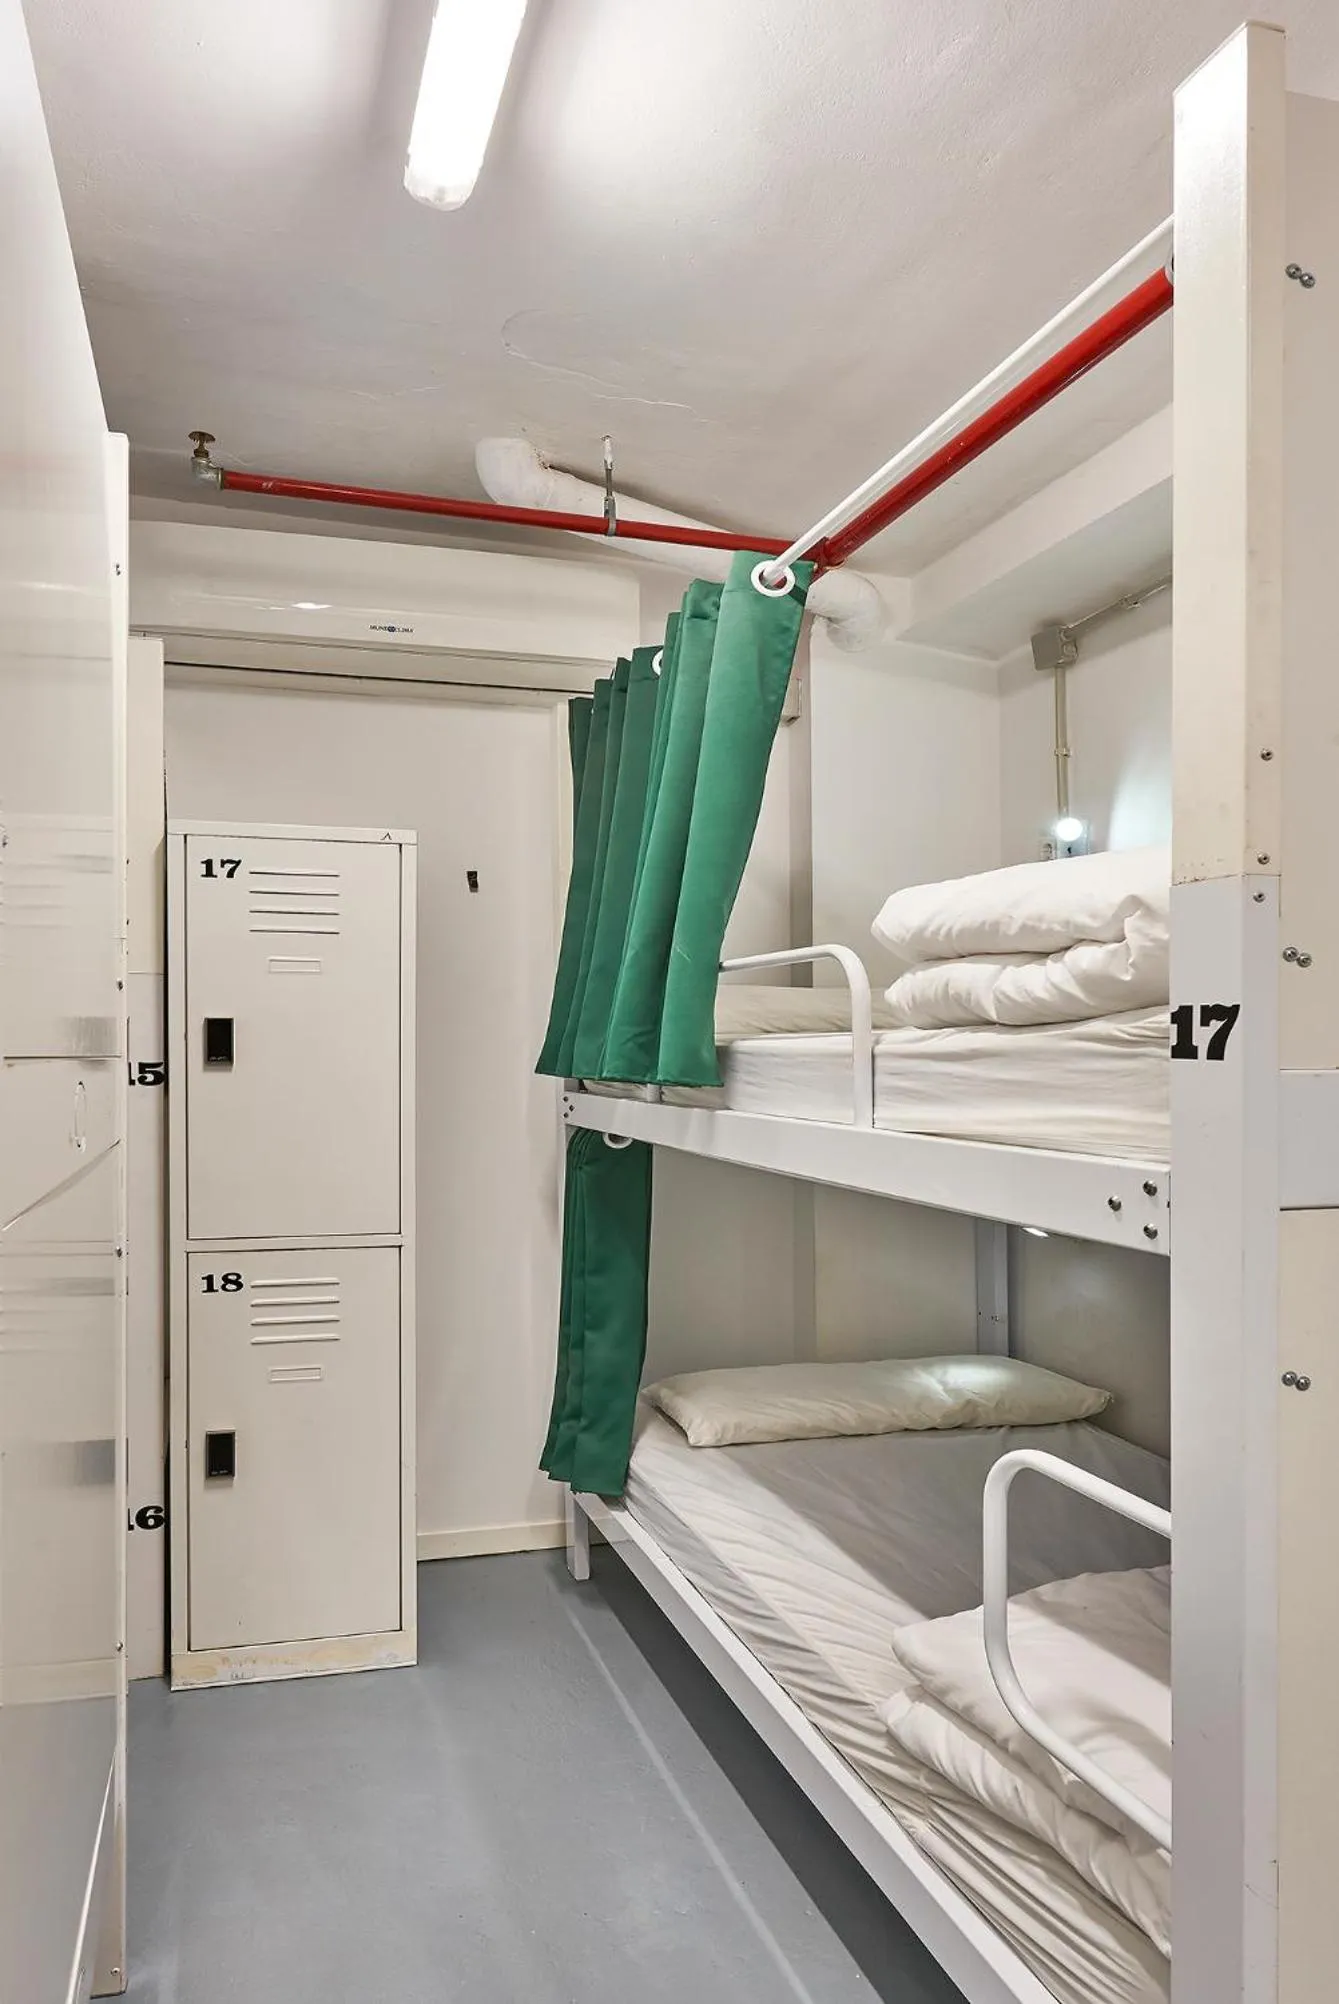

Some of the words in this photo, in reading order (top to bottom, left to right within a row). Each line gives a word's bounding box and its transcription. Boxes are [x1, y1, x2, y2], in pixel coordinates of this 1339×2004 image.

[200, 858, 242, 879] 17
[1170, 1003, 1241, 1061] 17
[201, 1272, 244, 1293] 18
